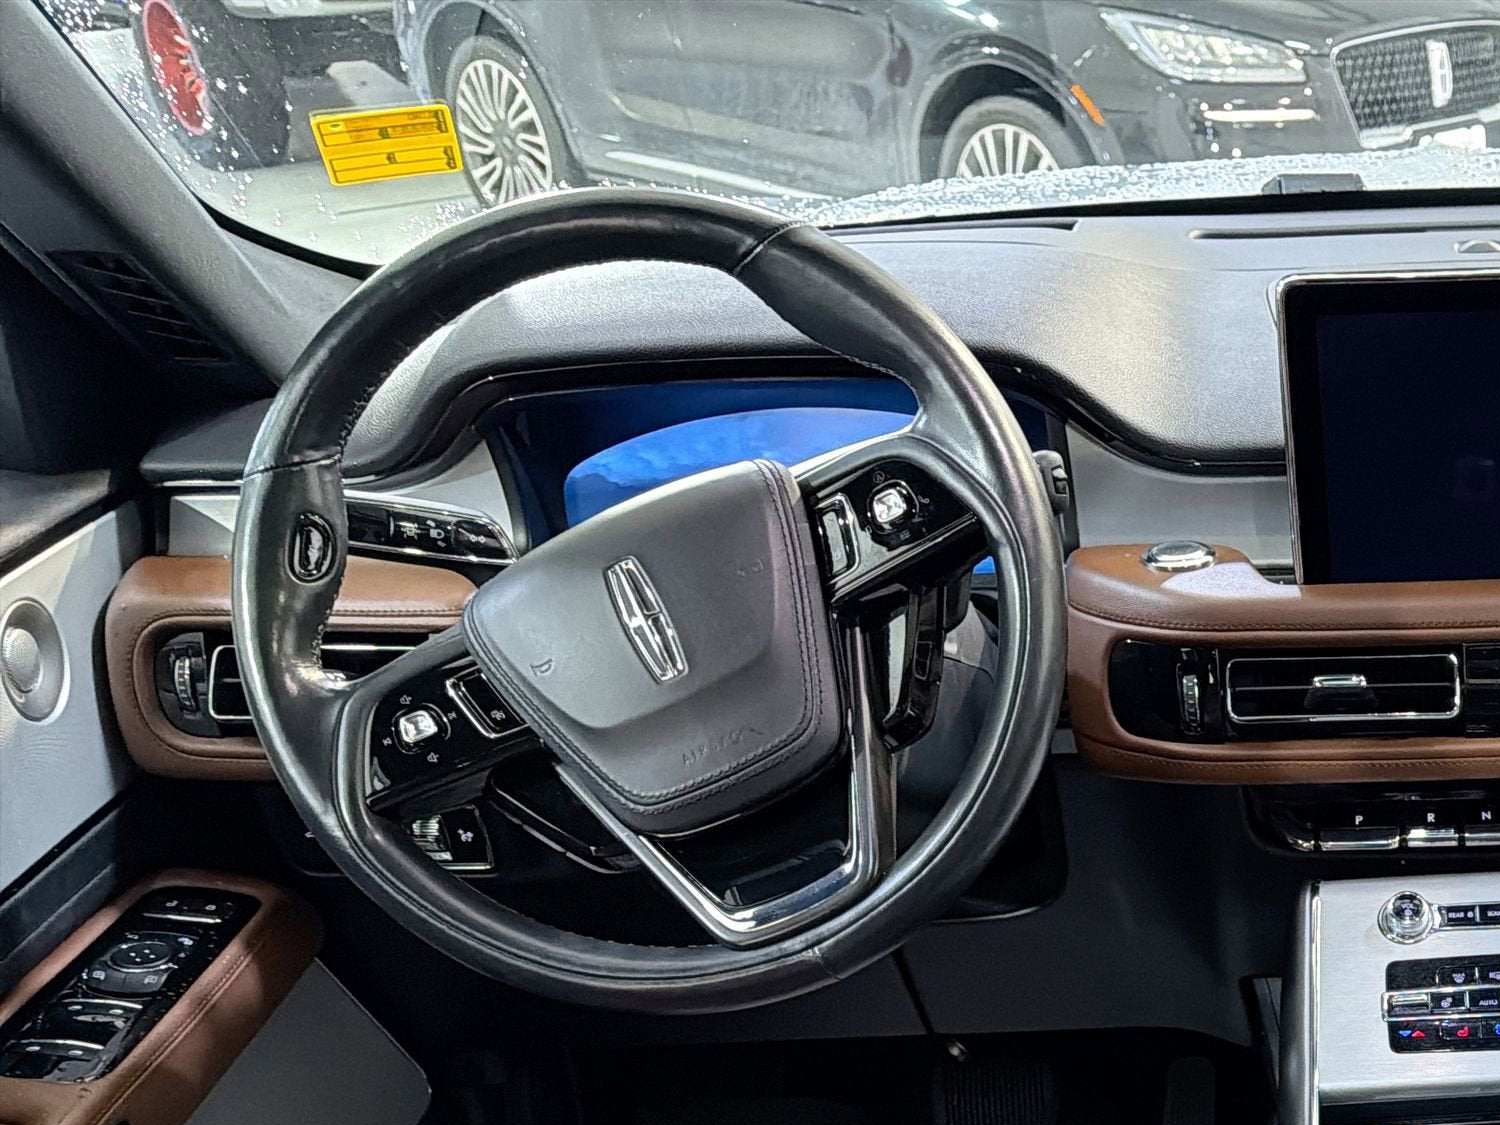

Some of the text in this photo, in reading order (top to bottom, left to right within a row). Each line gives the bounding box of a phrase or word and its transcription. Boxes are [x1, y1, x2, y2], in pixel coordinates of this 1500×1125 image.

[1355, 815, 1363, 825] P
[1427, 813, 1436, 823] R
[1481, 811, 1492, 821] N
